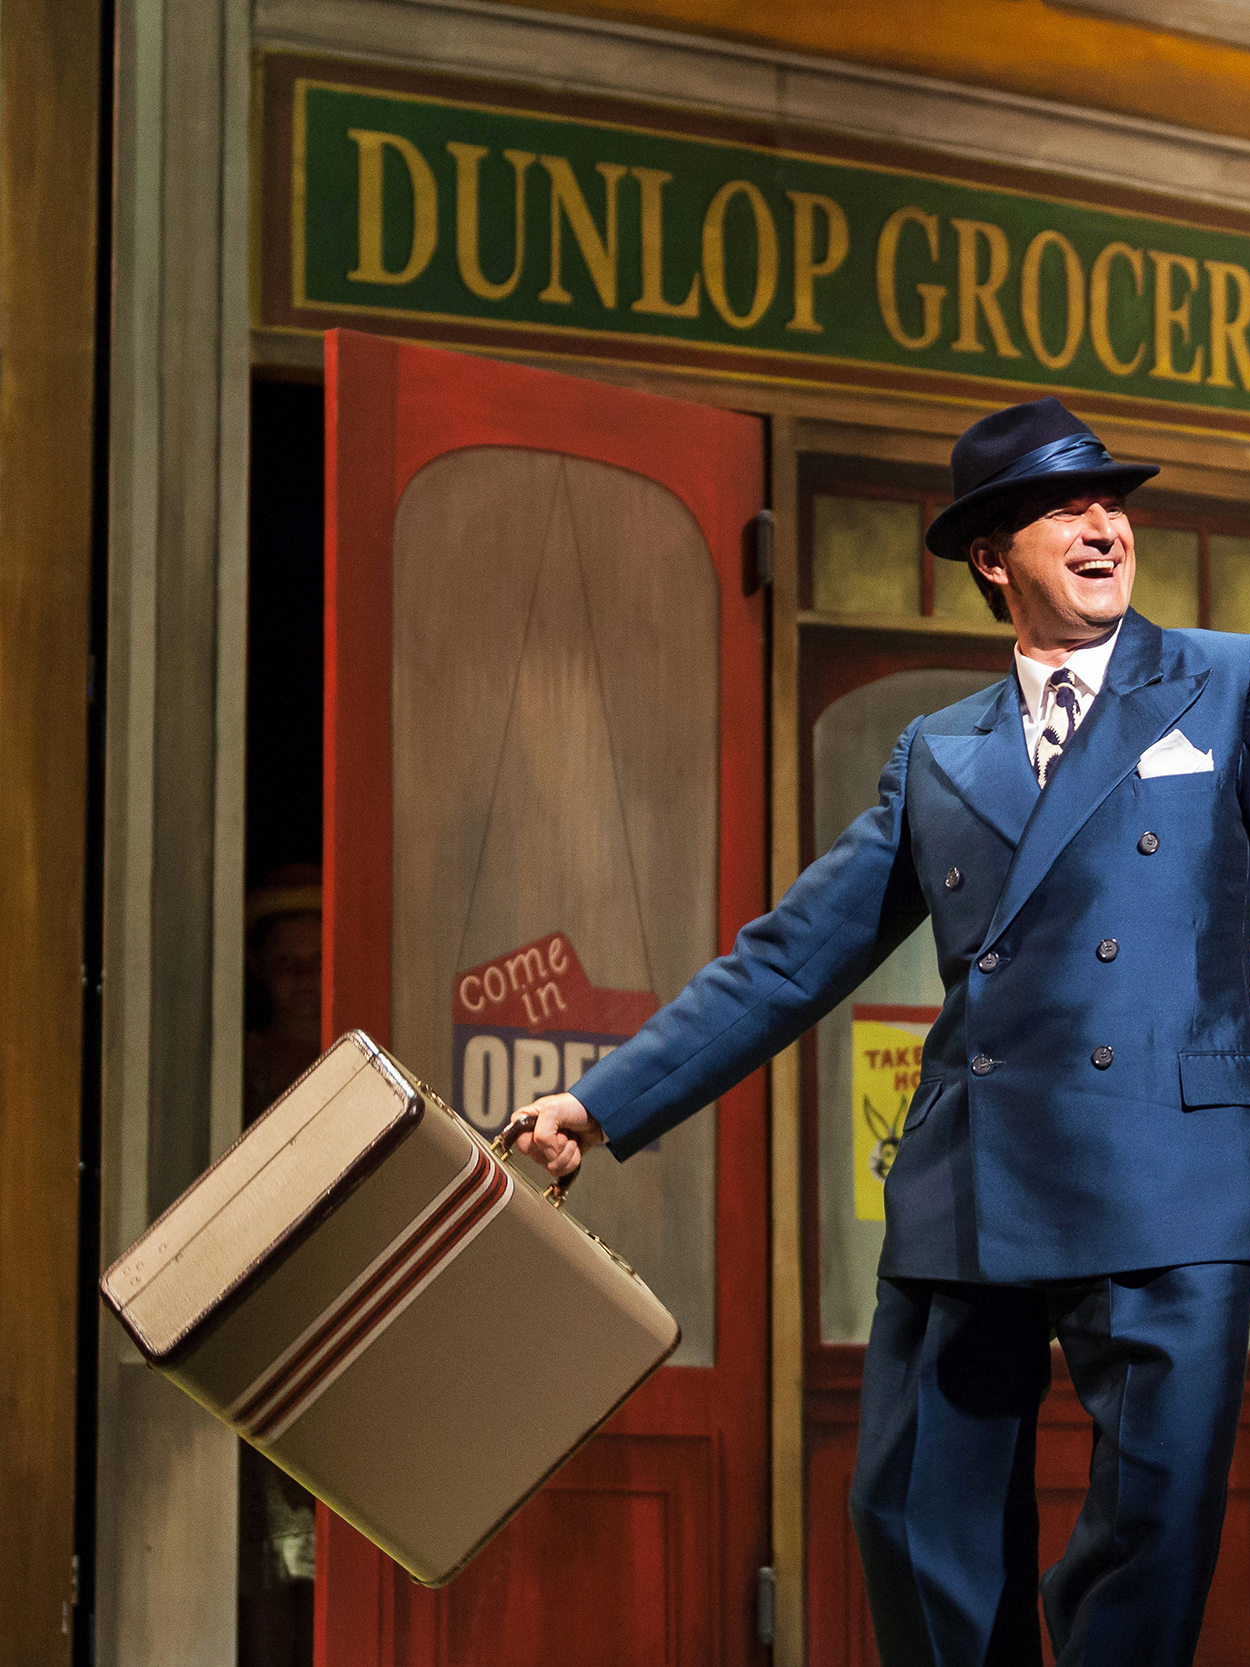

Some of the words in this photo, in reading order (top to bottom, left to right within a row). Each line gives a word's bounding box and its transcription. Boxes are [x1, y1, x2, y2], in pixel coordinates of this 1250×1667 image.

[346, 127, 849, 334] DUNLOP
[459, 937, 568, 1012] come
[521, 980, 567, 1025] in
[864, 1045, 923, 1069] TAKE
